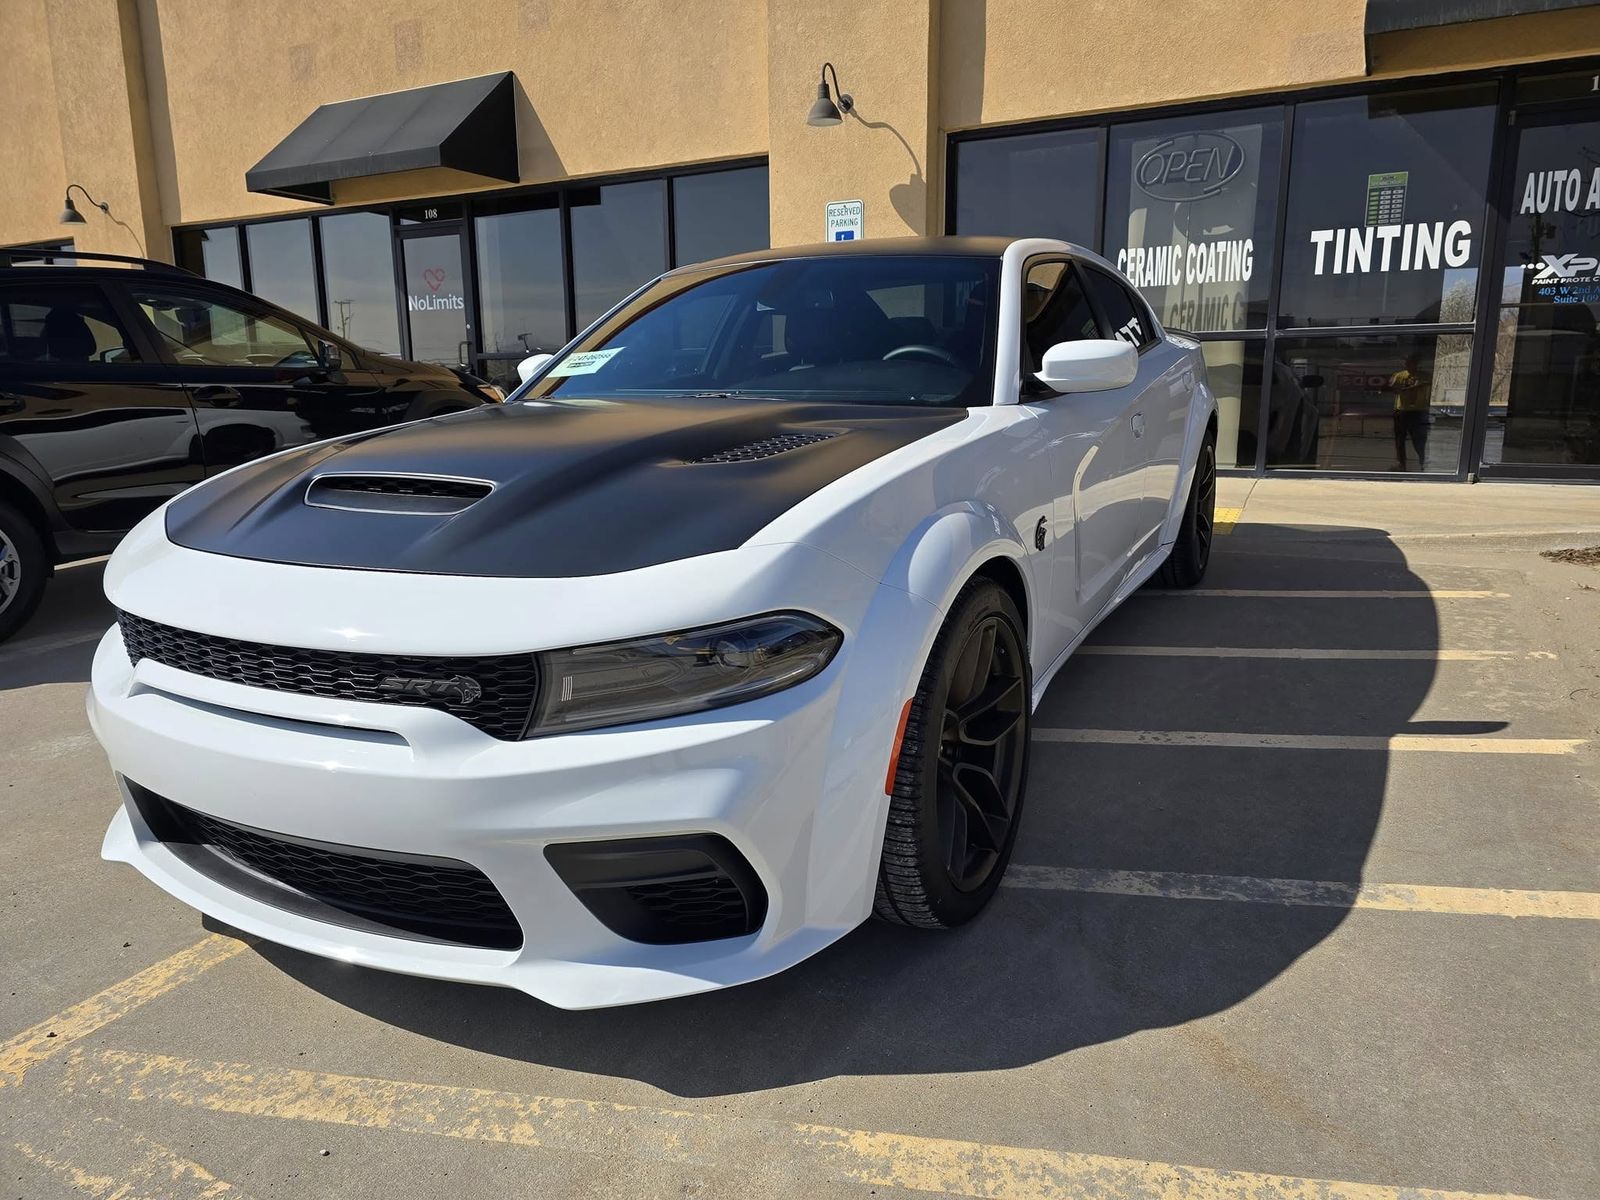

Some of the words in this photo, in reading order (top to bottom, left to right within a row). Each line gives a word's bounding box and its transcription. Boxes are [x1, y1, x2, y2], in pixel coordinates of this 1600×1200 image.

[1140, 145, 1235, 185] OPEN
[1520, 168, 1581, 215] AUTO
[424, 208, 438, 219] 108
[828, 206, 861, 217] RESERVED
[830, 218, 859, 228] PARKING
[1310, 219, 1472, 276] TINTING
[1117, 244, 1181, 288] CERAMIC
[1185, 238, 1254, 285] COATING
[1533, 253, 1600, 279] XP
[1531, 277, 1560, 285] PAINT
[1538, 286, 1556, 296] 403
[1560, 286, 1570, 295] W
[1572, 286, 1590, 295] 2nd
[1553, 294, 1579, 304] Suite
[408, 293, 465, 311] NoLimits
[379, 678, 460, 696] SRT
